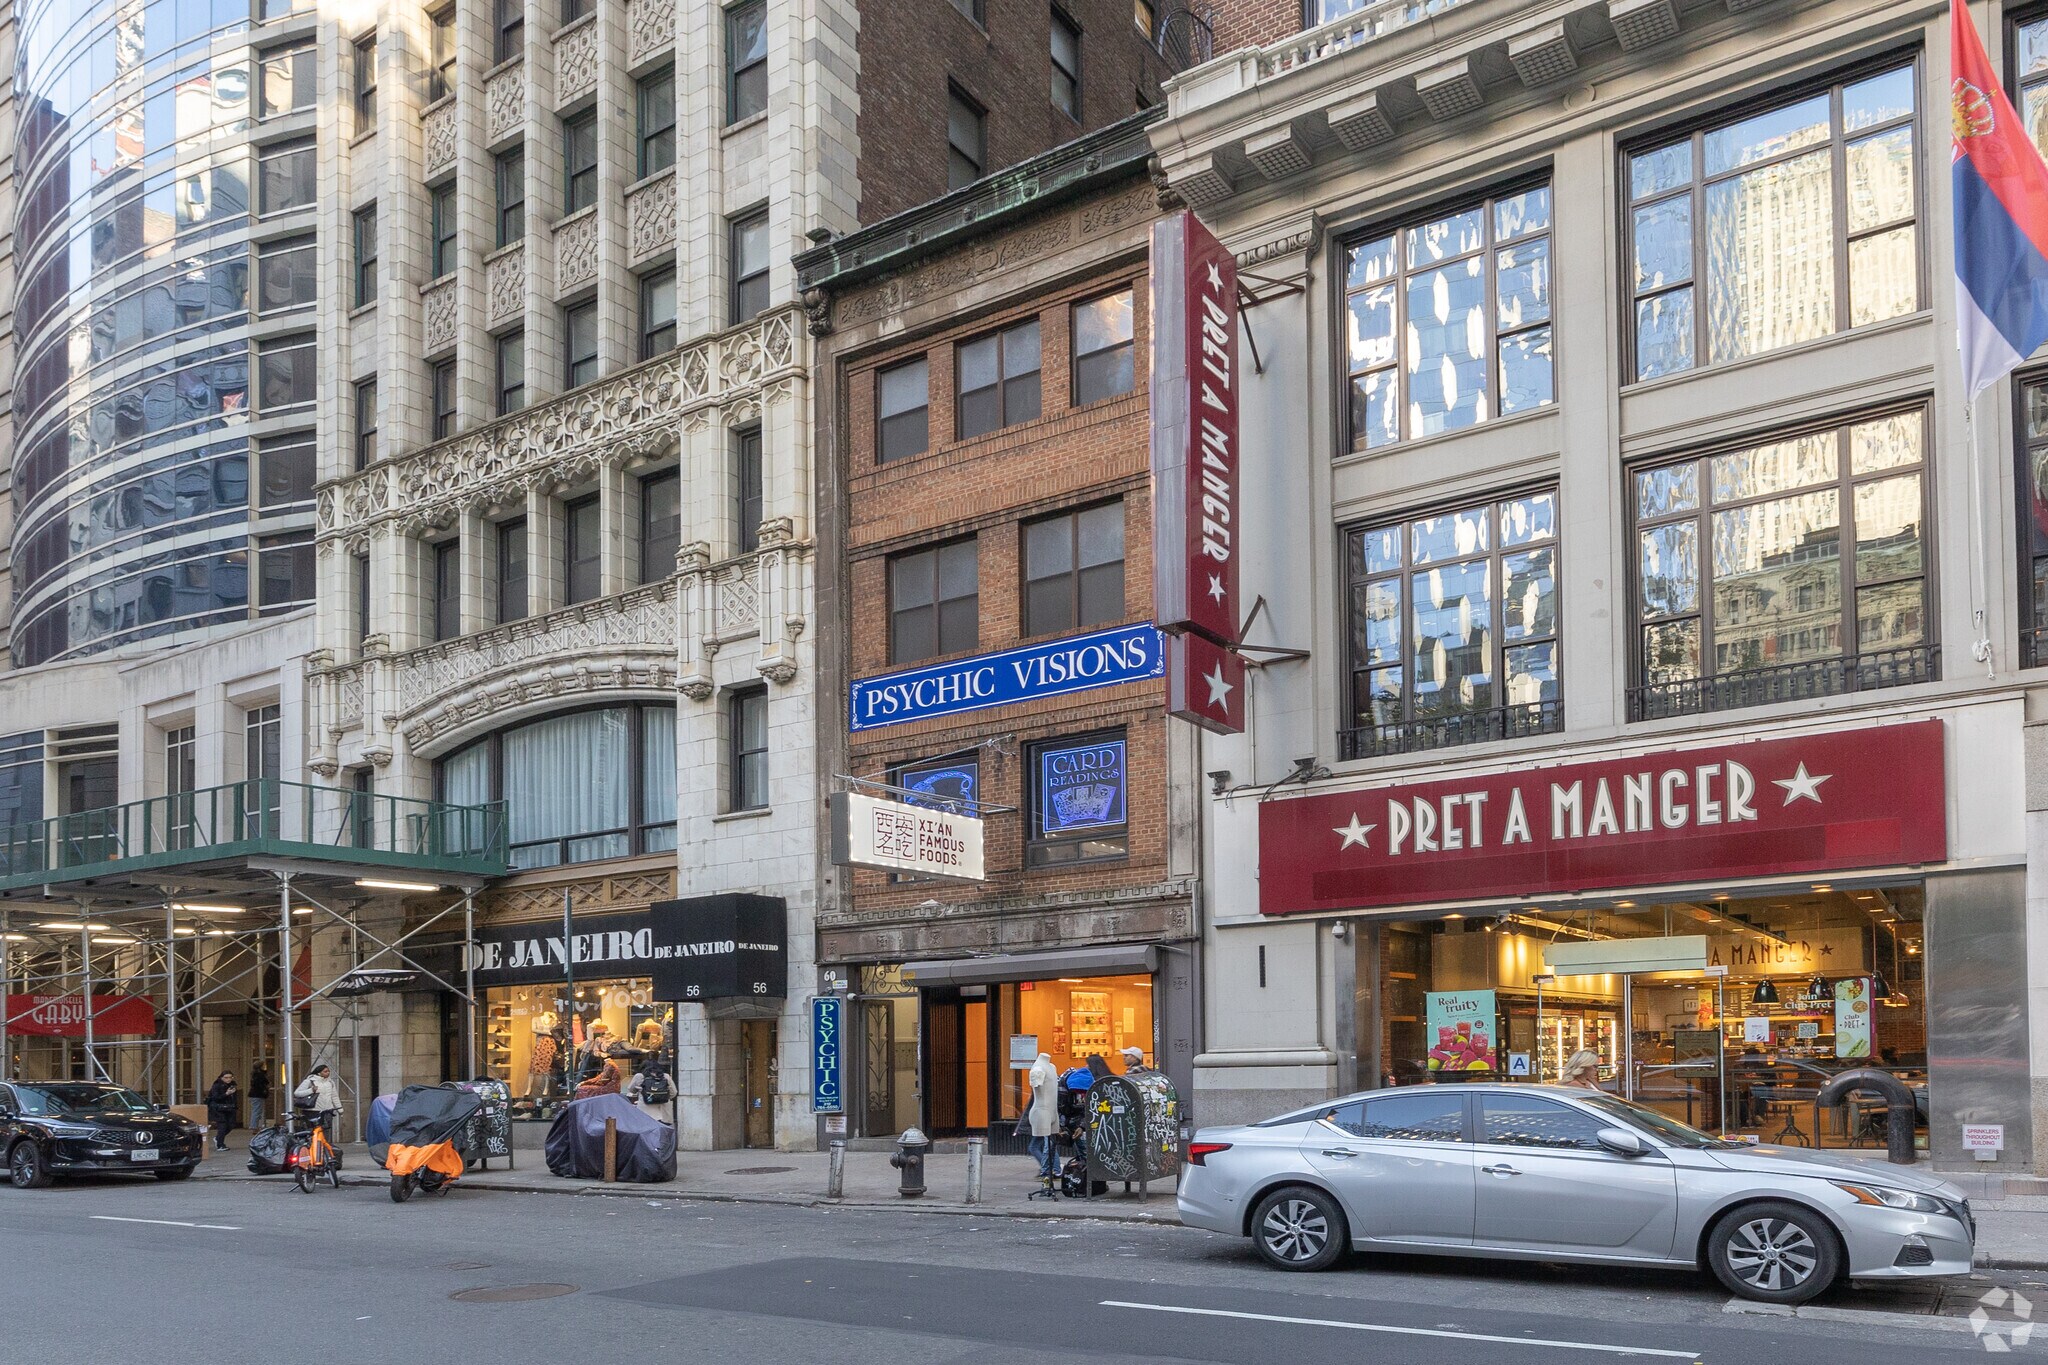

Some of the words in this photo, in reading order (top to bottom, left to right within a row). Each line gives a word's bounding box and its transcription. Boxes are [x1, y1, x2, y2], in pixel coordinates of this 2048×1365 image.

[1201, 293, 1230, 389] PRET
[1201, 379, 1229, 414] A
[1201, 416, 1231, 565] MANGER
[866, 666, 995, 718] PSYCHIC
[1010, 636, 1146, 688] VISIONS
[1052, 749, 1116, 774] CARD
[1049, 768, 1120, 787] READINGS
[1387, 790, 1490, 856] PRET
[1502, 788, 1532, 845] A
[1550, 759, 1759, 841] MANGER
[918, 818, 953, 837] XI'AN
[919, 835, 965, 853] FAMOUS
[919, 848, 957, 866] FOODS
[461, 941, 502, 972] DE
[509, 927, 653, 968] JANEIRO
[654, 945, 673, 960] DE
[674, 939, 736, 958] JANEIRO
[737, 942, 748, 950] DE
[748, 942, 779, 951] JANEIRO
[1710, 946, 1721, 967] A
[1731, 940, 1813, 966] MANGER
[824, 971, 836, 981] 60
[686, 985, 701, 997] 56
[752, 982, 767, 994] 56
[1797, 993, 1818, 1001] Join
[1437, 995, 1458, 1007] Real
[1445, 1001, 1480, 1013] fruity
[1784, 1001, 1808, 1009] Club
[1809, 1001, 1832, 1009] Pret
[32, 1004, 83, 1024] GABY
[1844, 1020, 1860, 1029] PRET
[818, 1004, 836, 1096] PSYCHIC
[1513, 1058, 1526, 1069] A
